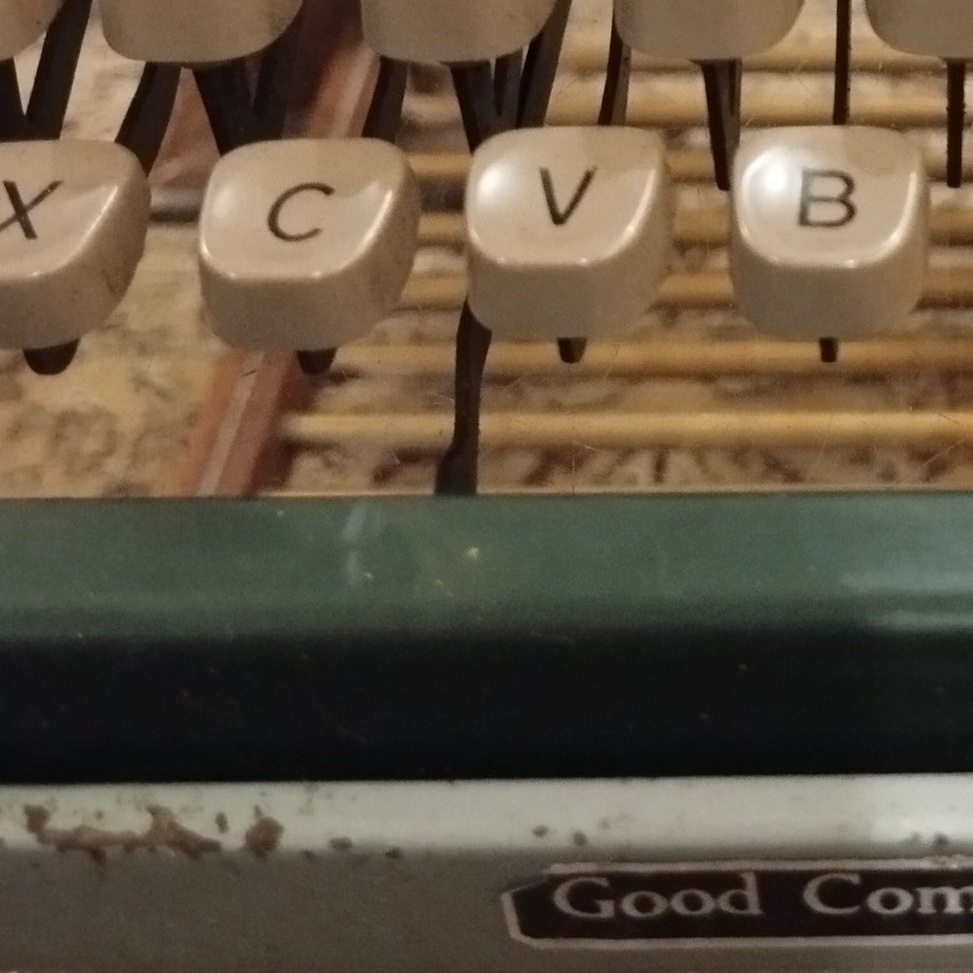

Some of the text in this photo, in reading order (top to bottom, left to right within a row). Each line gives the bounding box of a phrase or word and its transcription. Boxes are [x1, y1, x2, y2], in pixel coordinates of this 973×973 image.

[0, 180, 64, 240] X
[267, 182, 335, 242] C
[539, 166, 597, 226] V
[797, 167, 857, 228] B
[553, 871, 765, 920] Good
